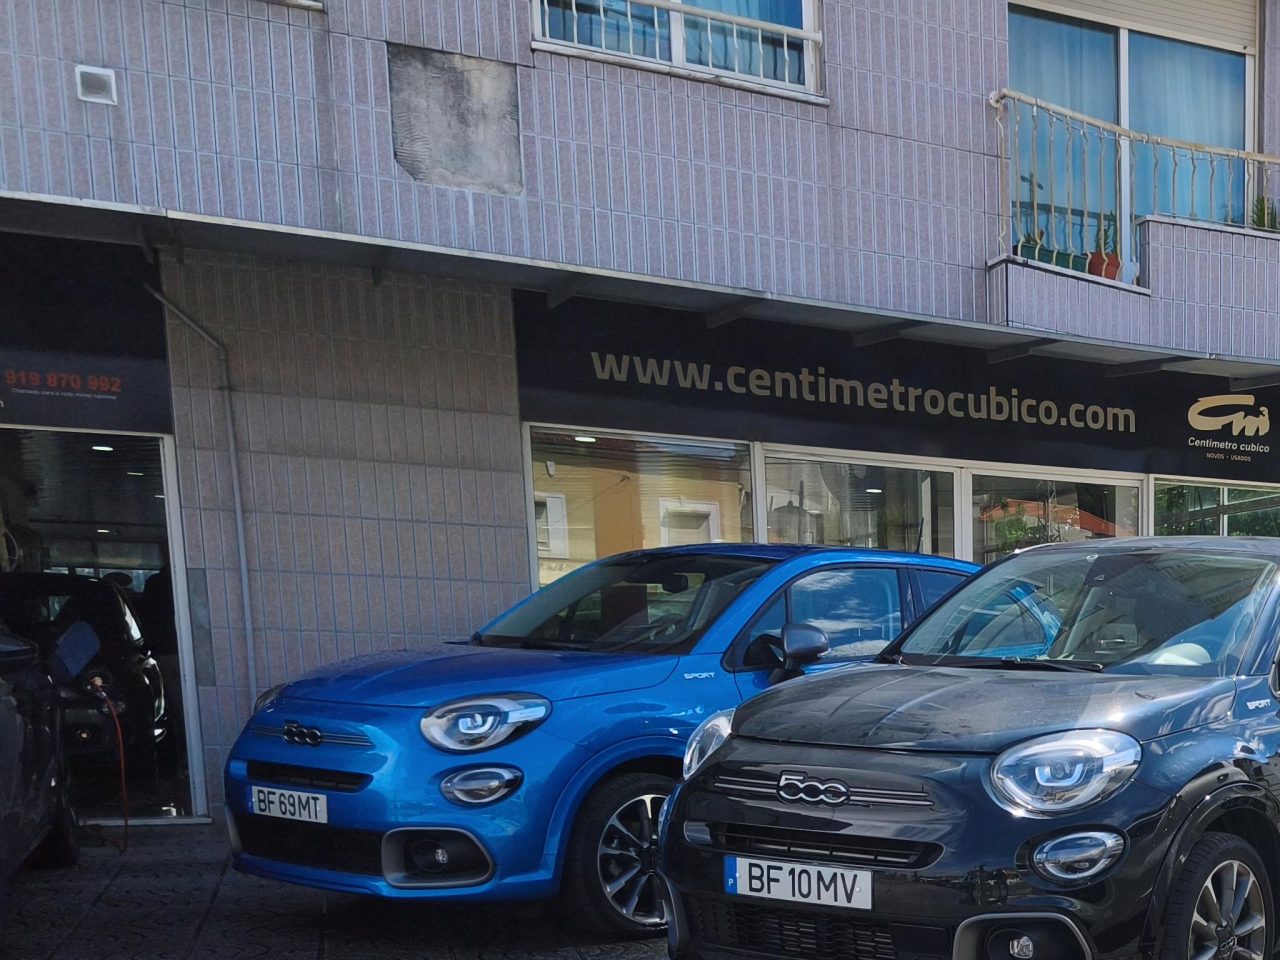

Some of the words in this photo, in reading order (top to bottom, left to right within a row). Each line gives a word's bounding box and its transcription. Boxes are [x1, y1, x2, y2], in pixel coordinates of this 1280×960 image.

[6, 369, 40, 386] 919
[47, 372, 81, 390] 870
[88, 375, 121, 393] 992
[590, 351, 1136, 433] www.centimetrocubico.com
[683, 671, 716, 680] SPORT
[283, 721, 322, 746] 500
[778, 773, 848, 804] 500
